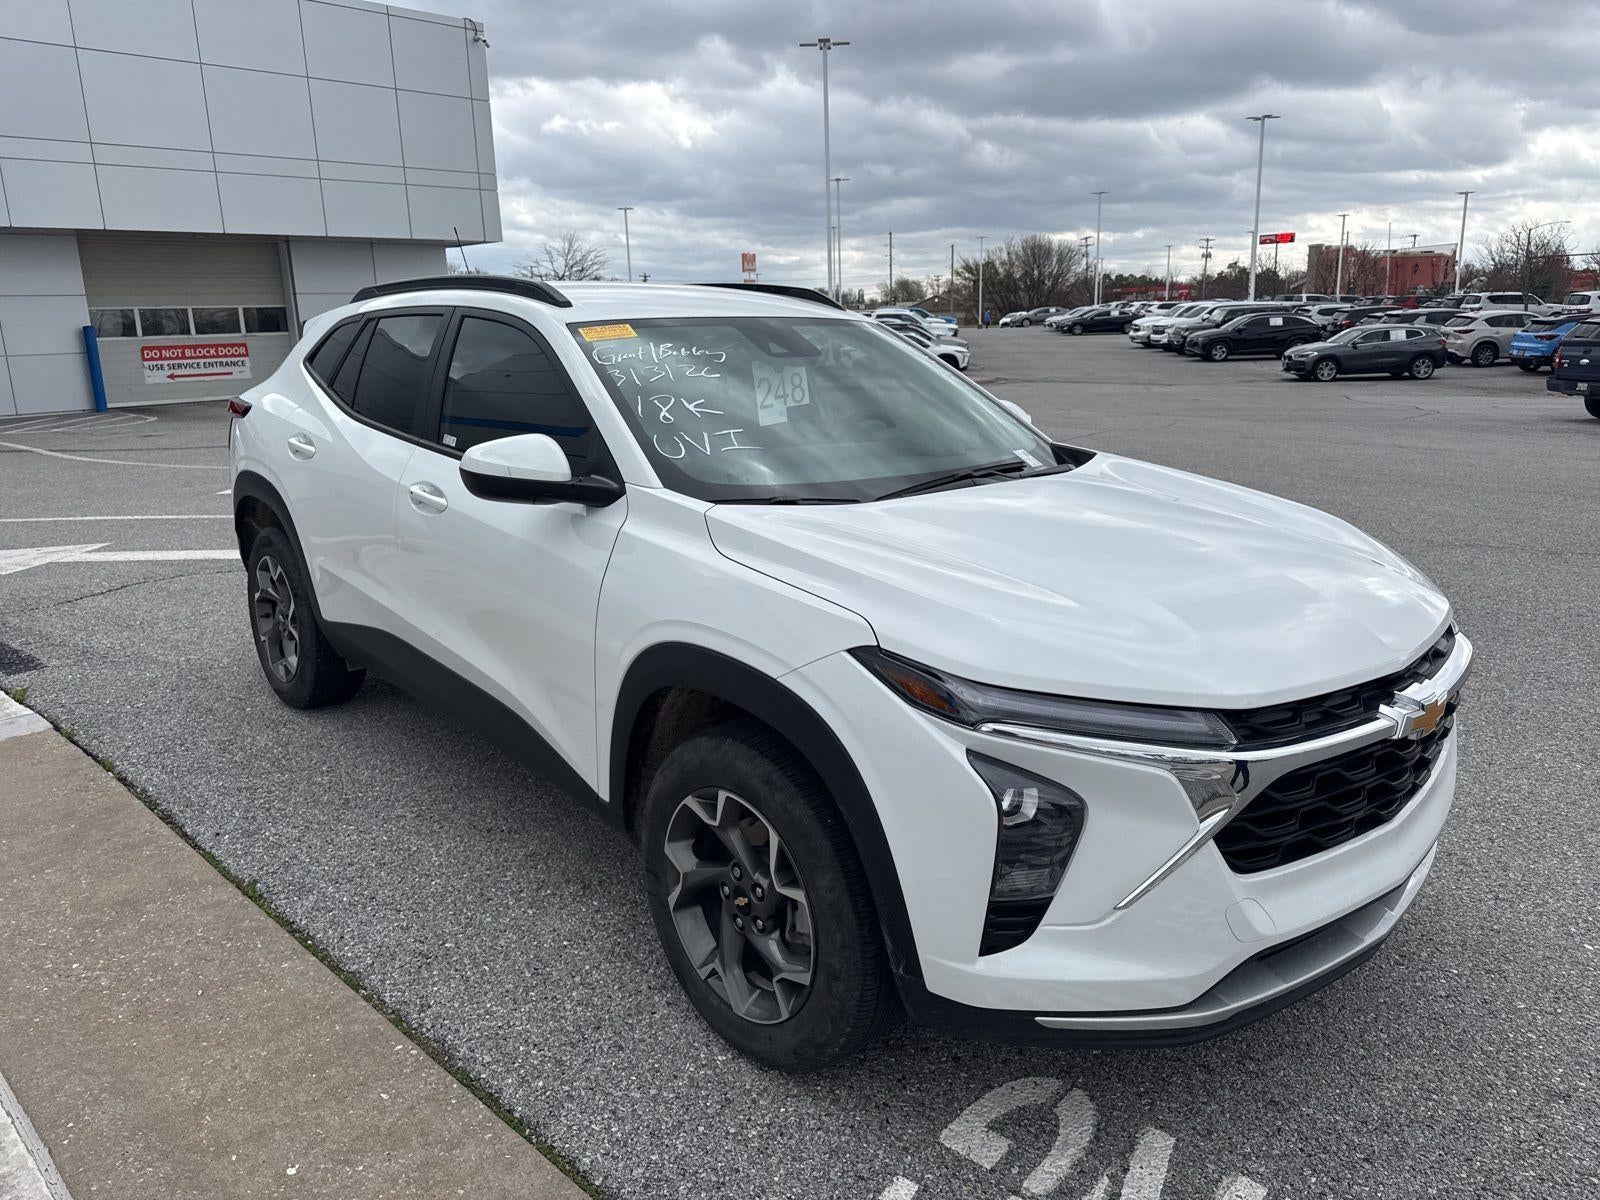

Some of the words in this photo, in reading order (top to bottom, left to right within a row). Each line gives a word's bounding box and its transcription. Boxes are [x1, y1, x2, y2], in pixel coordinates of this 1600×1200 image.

[144, 349, 160, 359] DO
[162, 348, 183, 358] NOT
[184, 347, 217, 357] BLOCK
[218, 346, 246, 356] DOOR
[148, 363, 165, 372] USE
[166, 361, 201, 371] SERVICE
[203, 360, 246, 369] ENTRANCE
[757, 372, 805, 409] 248
